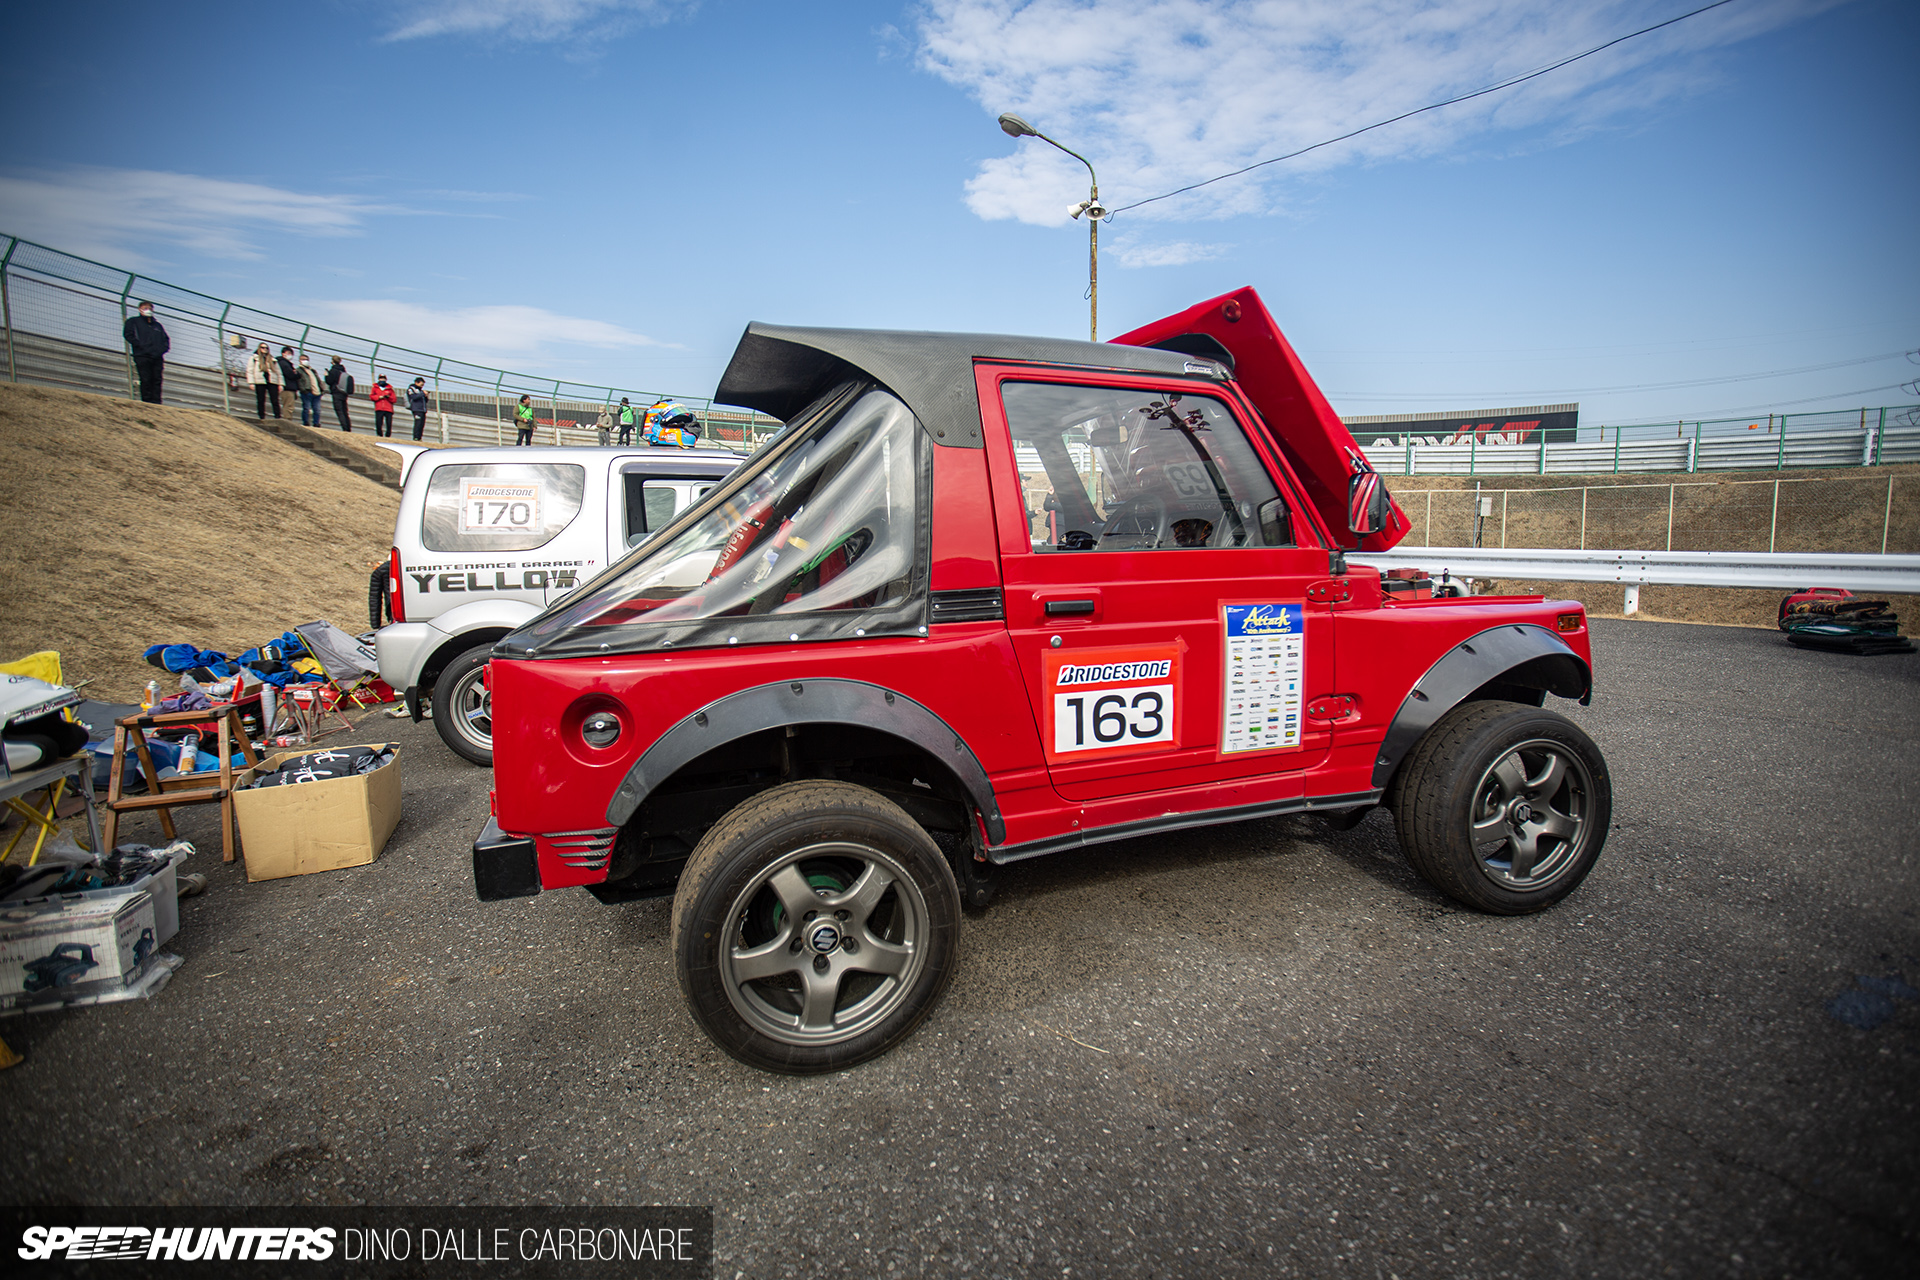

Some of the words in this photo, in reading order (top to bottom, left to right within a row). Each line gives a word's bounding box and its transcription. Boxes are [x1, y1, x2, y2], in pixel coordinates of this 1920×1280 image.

[470, 488, 534, 497] BRIDGESTONE
[474, 501, 530, 525] 170
[405, 562, 517, 573] MAINTENANCE
[521, 560, 584, 568] GARAGE
[410, 569, 578, 593] YELLOW
[1241, 605, 1291, 629] Attack
[1059, 660, 1169, 684] BRIDGESTONE
[1066, 691, 1163, 746] 163
